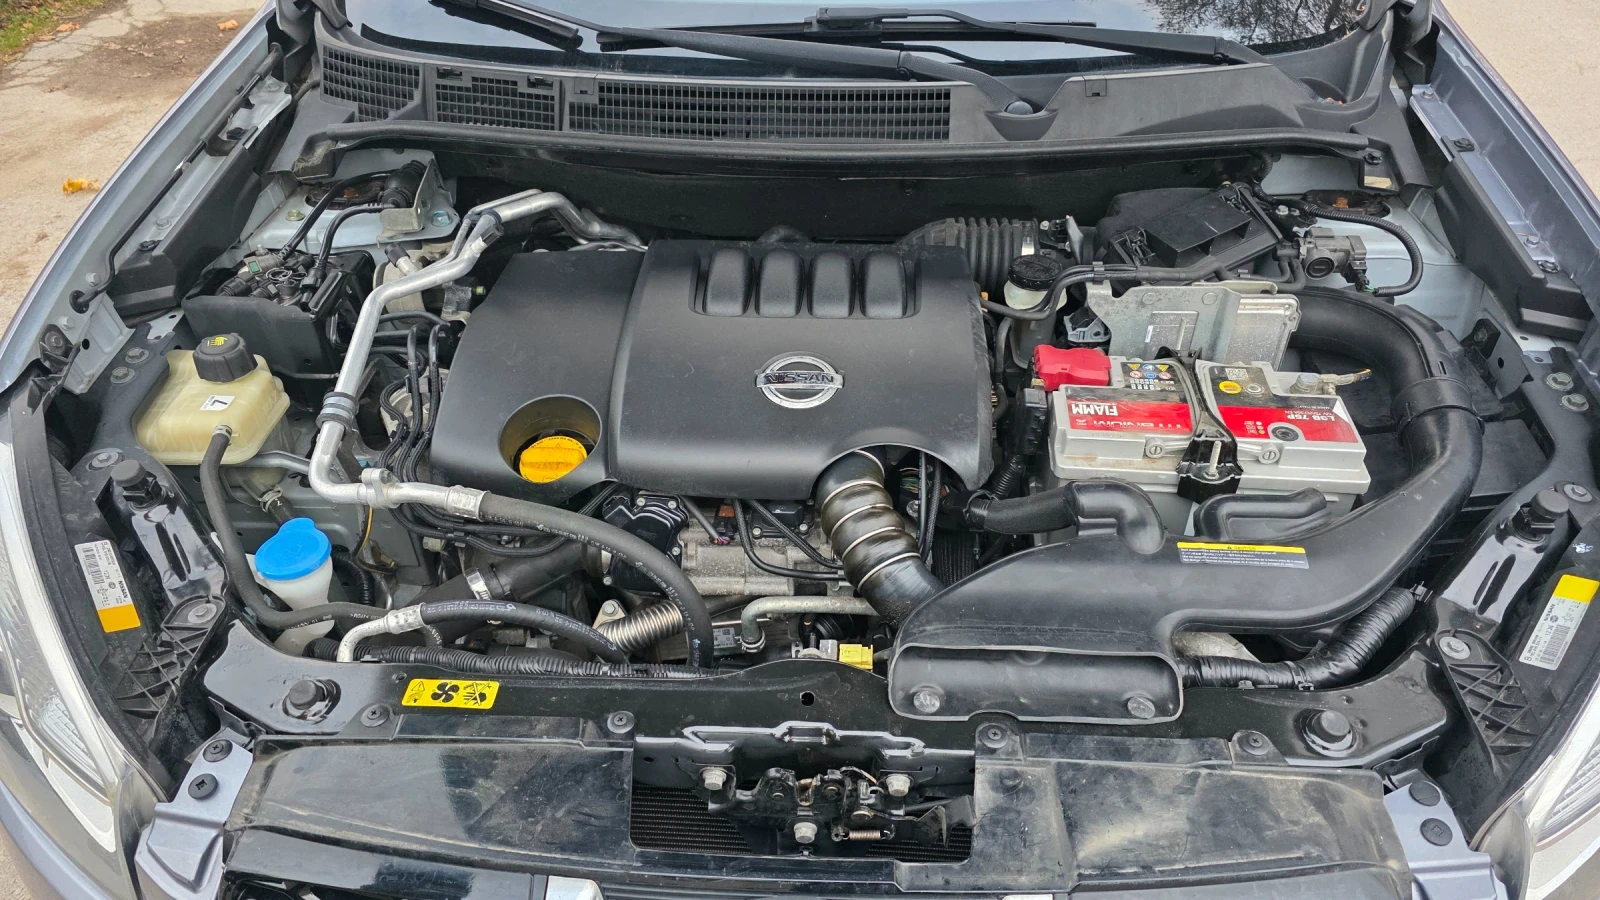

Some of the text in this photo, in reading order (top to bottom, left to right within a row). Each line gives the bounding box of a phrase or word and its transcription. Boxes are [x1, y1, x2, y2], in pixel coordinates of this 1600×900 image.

[763, 373, 835, 384] NISSAN
[1071, 403, 1119, 416] FIAMM
[118, 581, 128, 599] NISSAN
[1544, 603, 1556, 622] NISSAN
